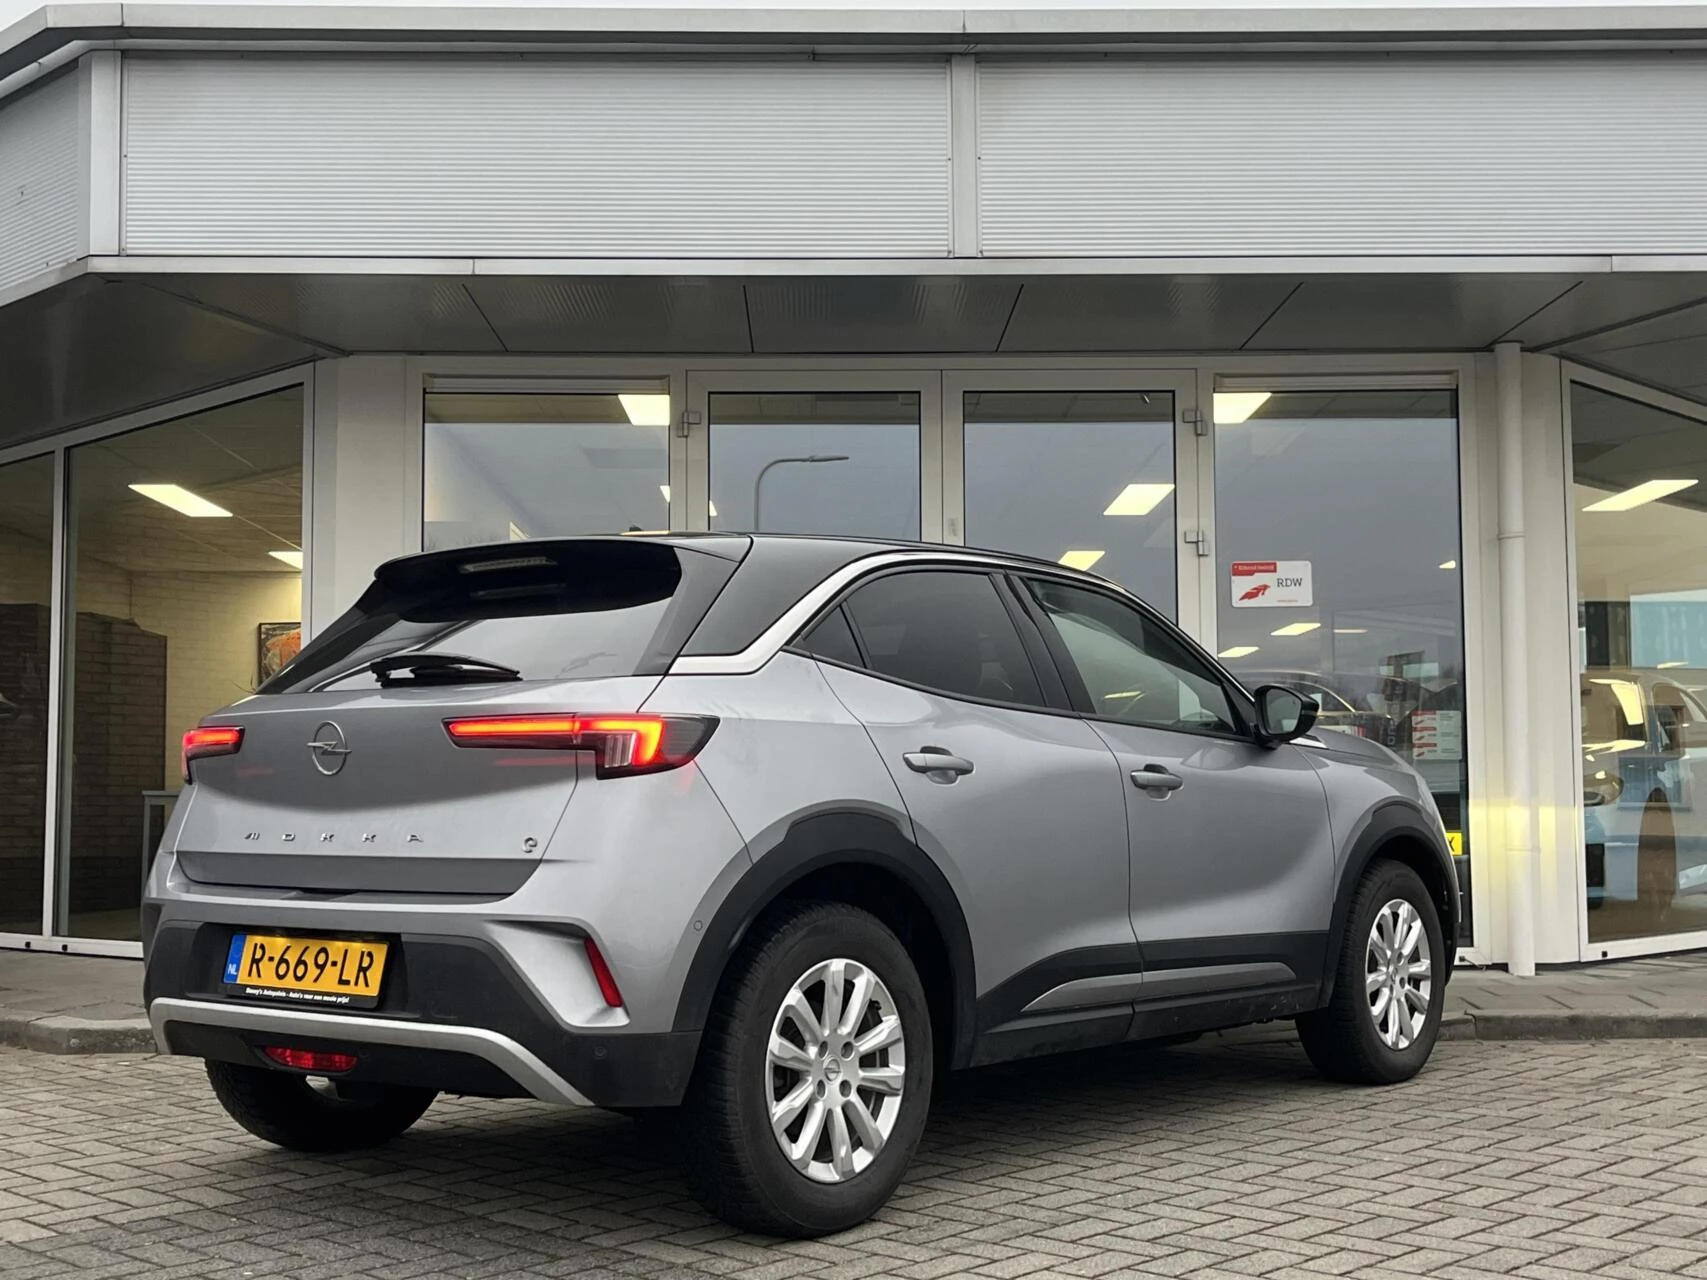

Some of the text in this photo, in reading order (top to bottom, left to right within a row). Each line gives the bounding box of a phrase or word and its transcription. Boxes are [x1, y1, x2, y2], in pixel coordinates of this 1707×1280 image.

[1276, 577, 1303, 588] RDW
[227, 963, 238, 975] NL
[248, 943, 375, 988] R-669-LR
